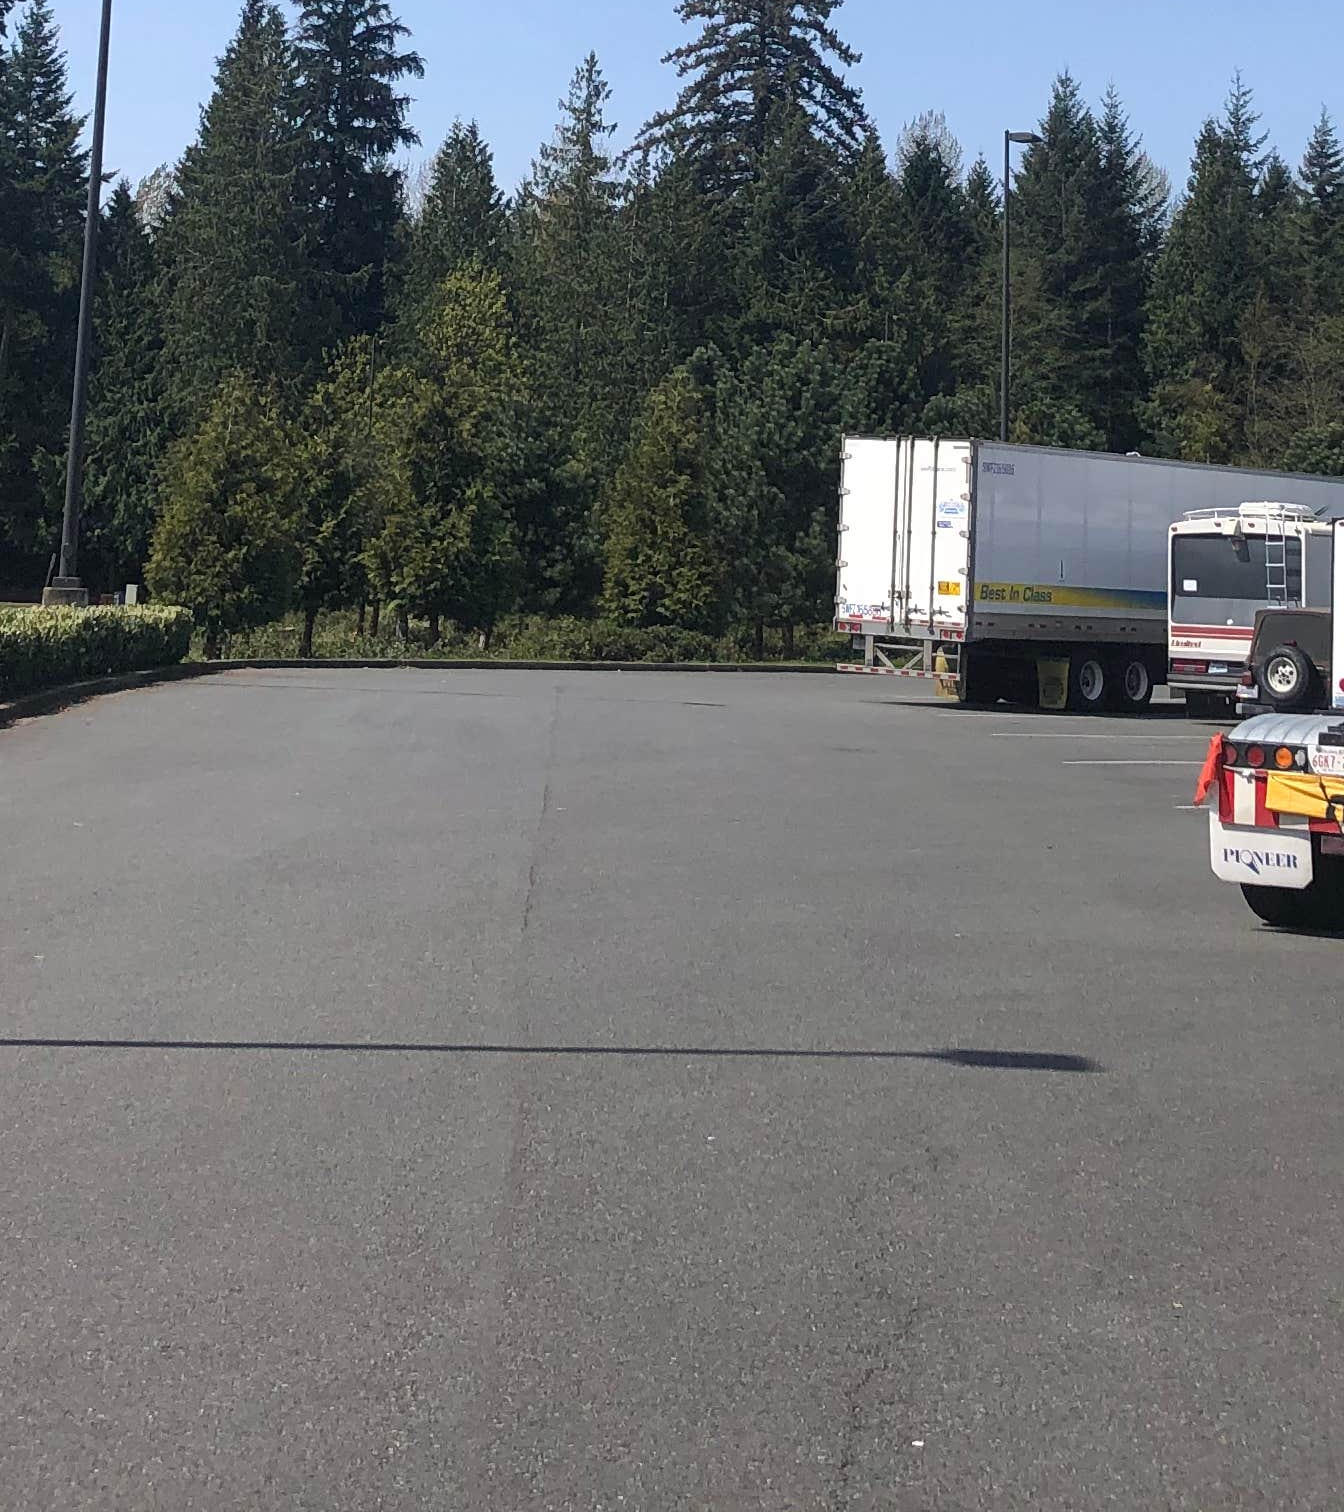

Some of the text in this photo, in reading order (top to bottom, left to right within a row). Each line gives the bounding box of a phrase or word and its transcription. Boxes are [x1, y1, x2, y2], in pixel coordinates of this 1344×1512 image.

[979, 584, 1007, 601] Best
[1009, 586, 1020, 601] In
[1022, 586, 1053, 603] Class
[1223, 848, 1298, 874] PIONEER
